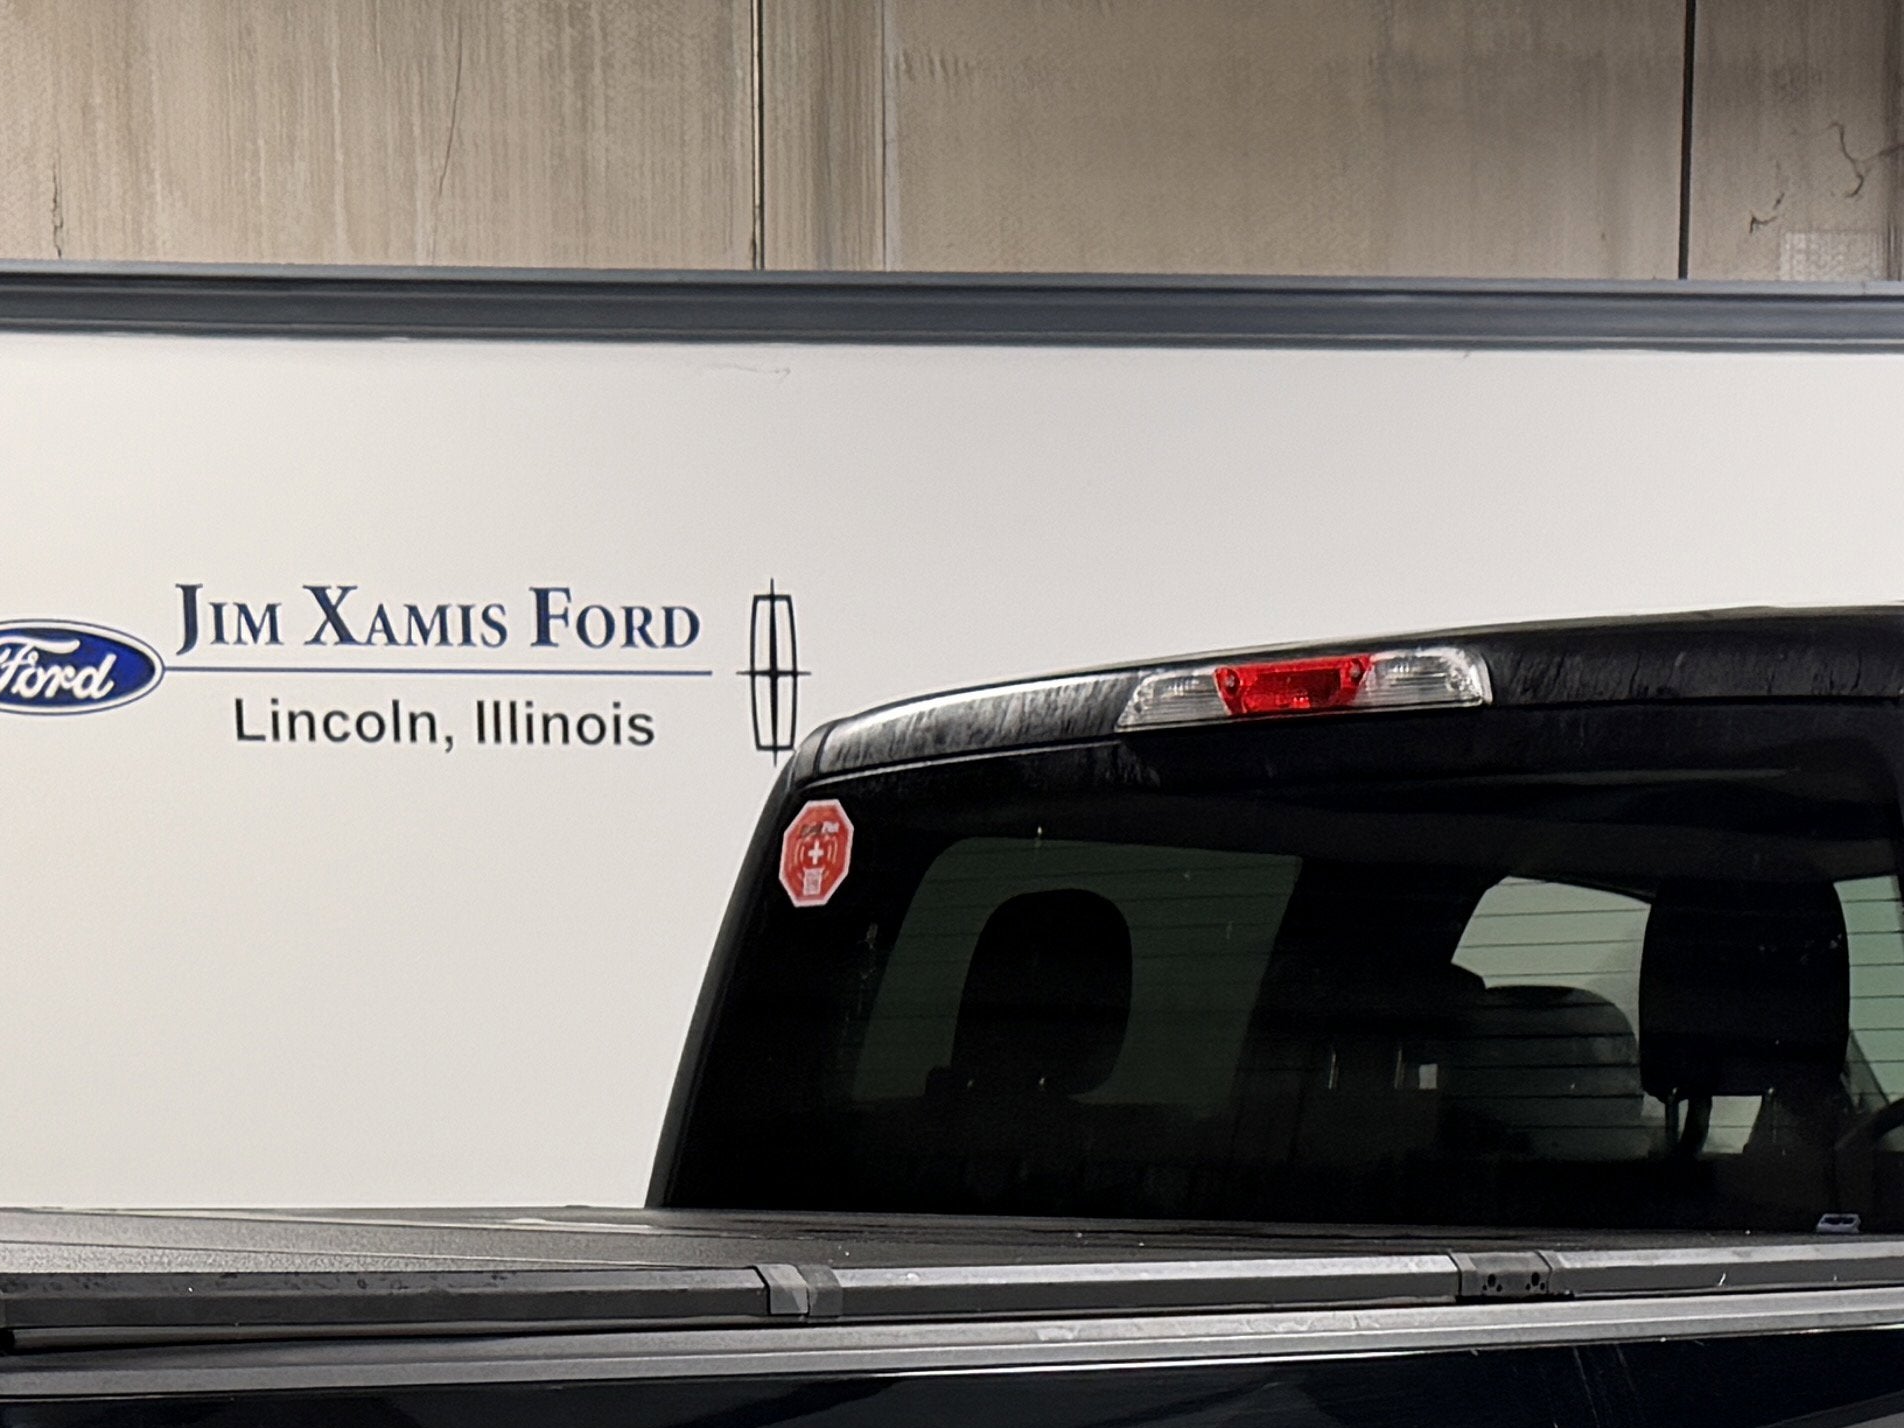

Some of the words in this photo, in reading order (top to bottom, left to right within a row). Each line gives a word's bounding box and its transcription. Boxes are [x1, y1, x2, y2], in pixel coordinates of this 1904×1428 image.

[175, 583, 284, 656] JIM
[302, 585, 509, 650] XAMIS
[529, 587, 702, 650] FORD
[234, 699, 456, 754] Lincoln,
[475, 700, 656, 747] Illinois
